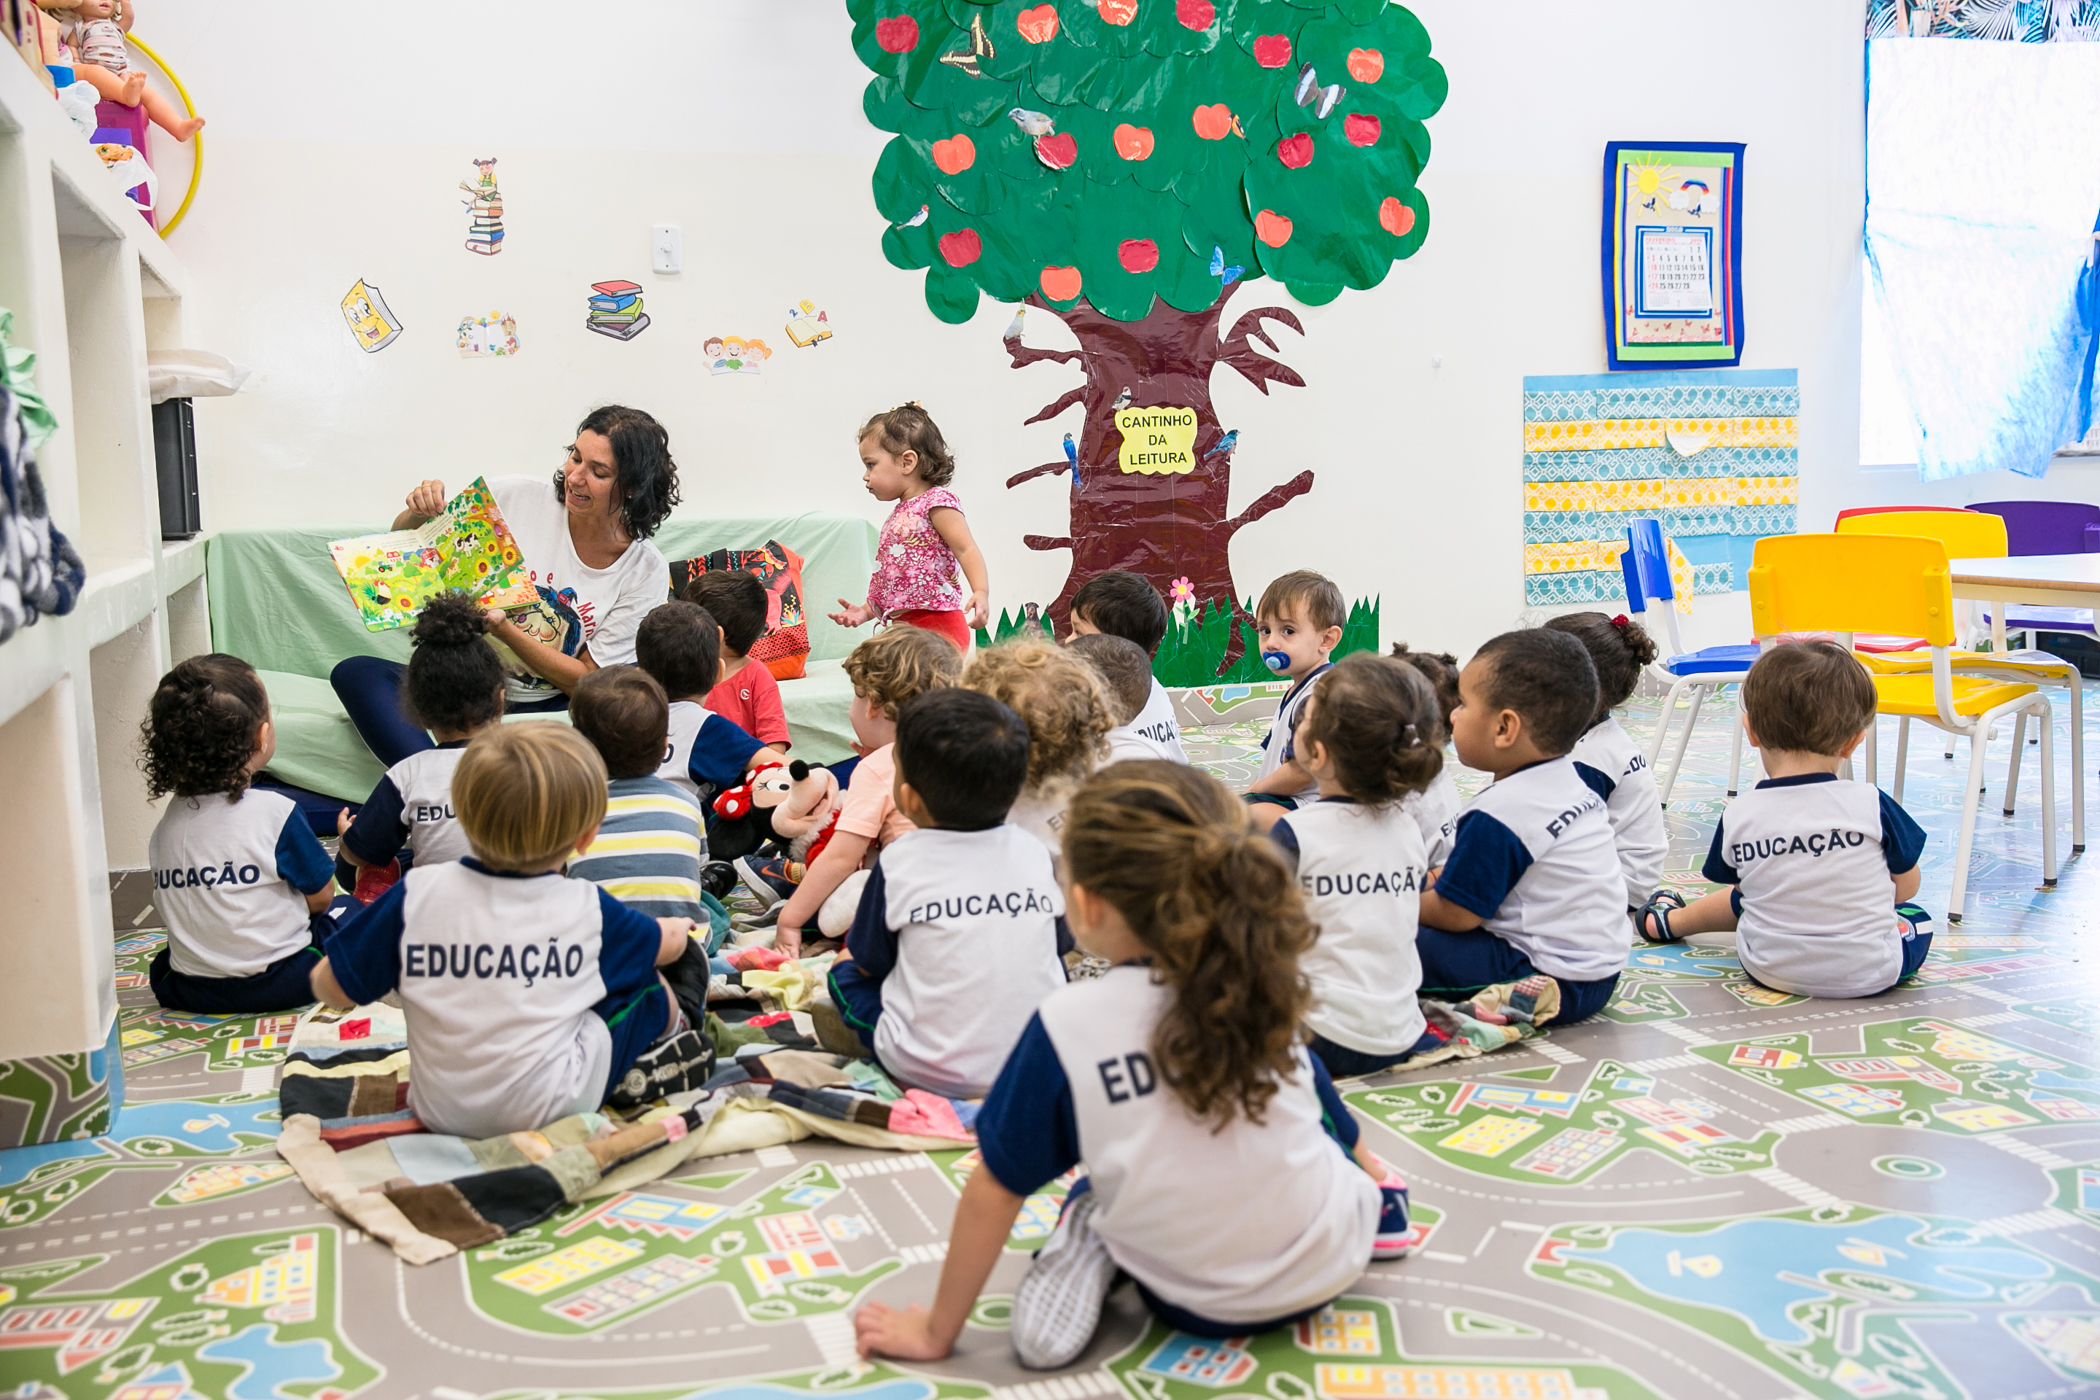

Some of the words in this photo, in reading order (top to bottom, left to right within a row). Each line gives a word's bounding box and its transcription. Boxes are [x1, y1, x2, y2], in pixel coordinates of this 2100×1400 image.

[799, 299, 815, 315] B
[817, 310, 828, 322] A
[1122, 415, 1193, 428] CANTINHO
[1148, 434, 1168, 446] DA
[1130, 452, 1187, 465] LEITURA
[1731, 828, 1865, 863] EDUCAÇÃO
[1300, 866, 1421, 897] EDUCAÇÃ
[909, 887, 1053, 924] EDUCAÇÃO
[405, 936, 584, 988] EDUCAÇÃO
